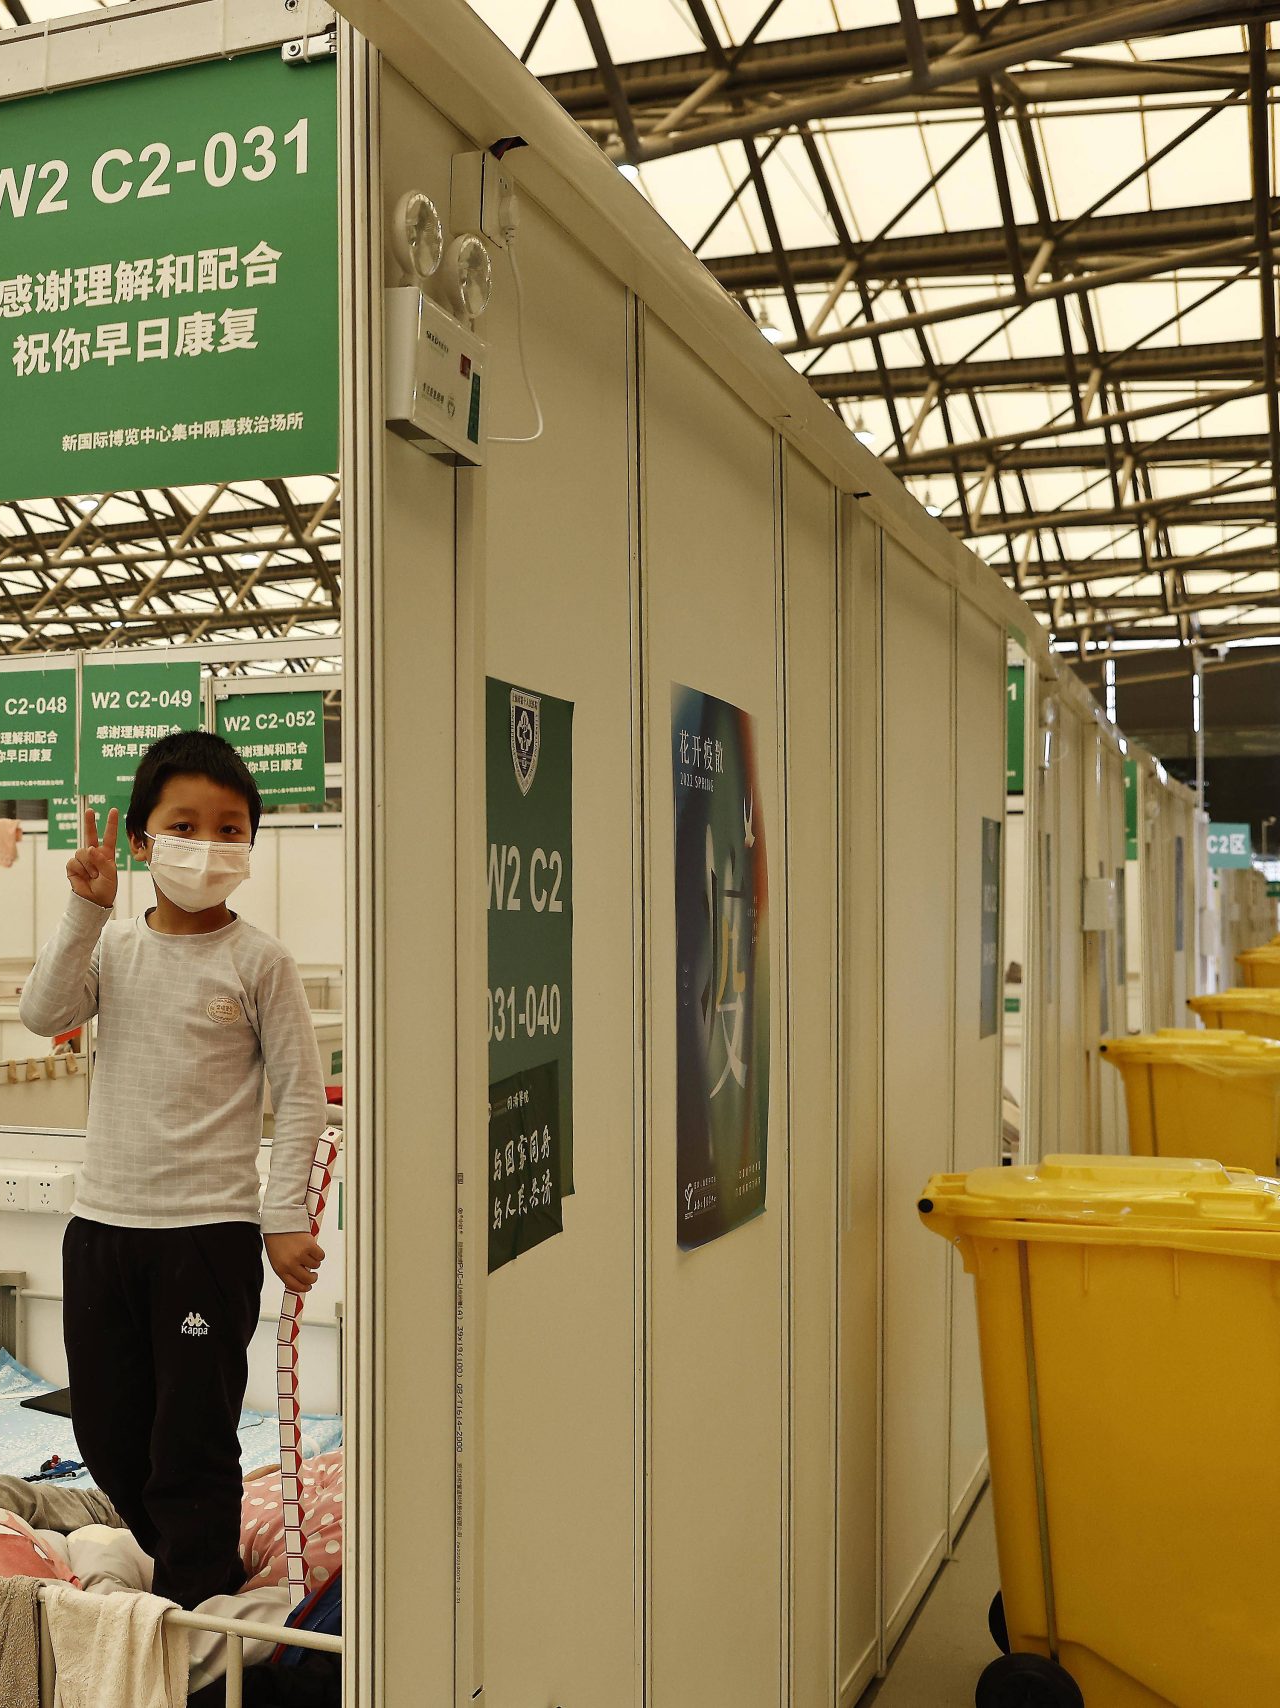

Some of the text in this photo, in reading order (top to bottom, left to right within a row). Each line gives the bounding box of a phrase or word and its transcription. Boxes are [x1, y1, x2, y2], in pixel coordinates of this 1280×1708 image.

[90, 118, 310, 205] C2-031
[12, 307, 259, 377] 祝你早日康复
[61, 411, 304, 453] 新国际博览中心集中隔离救治场所
[5, 696, 67, 715] C2-048
[91, 690, 192, 709] W2 C2-049
[223, 710, 316, 732] W2 C2-052
[679, 729, 724, 774] 花开疫散
[244, 758, 303, 773] 你早日康复
[1206, 833, 1247, 855] C2区
[487, 843, 563, 913] W2 C2
[181, 1325, 208, 1337] Kappa
